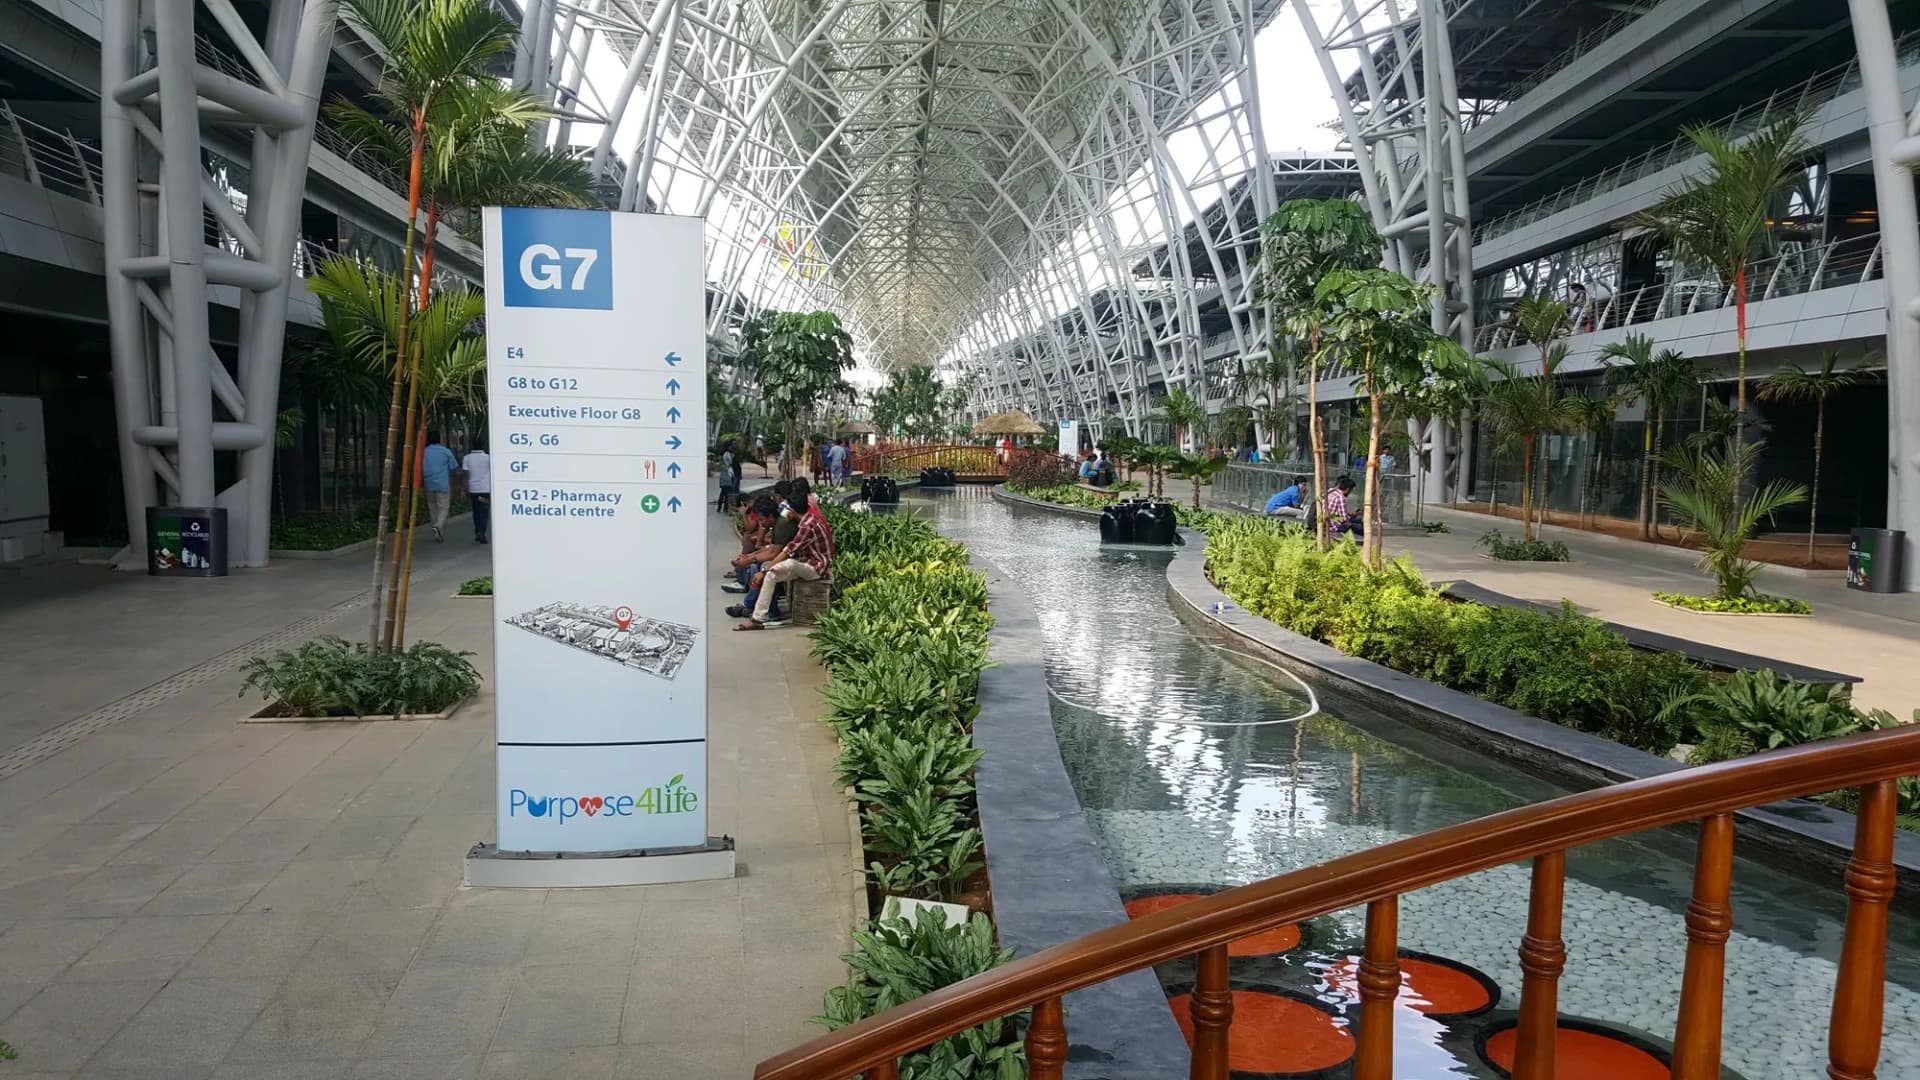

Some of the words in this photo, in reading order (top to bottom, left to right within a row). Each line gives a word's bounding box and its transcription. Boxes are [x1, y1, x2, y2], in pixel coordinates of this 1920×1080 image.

[519, 243, 599, 291] G7
[507, 347, 524, 359] E4
[508, 377, 527, 390] G8
[531, 378, 546, 390] to
[549, 378, 578, 391] G12
[508, 405, 577, 419] Executive
[580, 406, 618, 420] Floor
[621, 408, 641, 420] G8
[509, 433, 533, 447] G5,
[539, 434, 559, 446] G6
[510, 460, 529, 473] GF
[511, 489, 539, 501] G12
[551, 490, 622, 505] Pharmacy
[511, 504, 566, 517] Medical
[570, 506, 615, 518] centre
